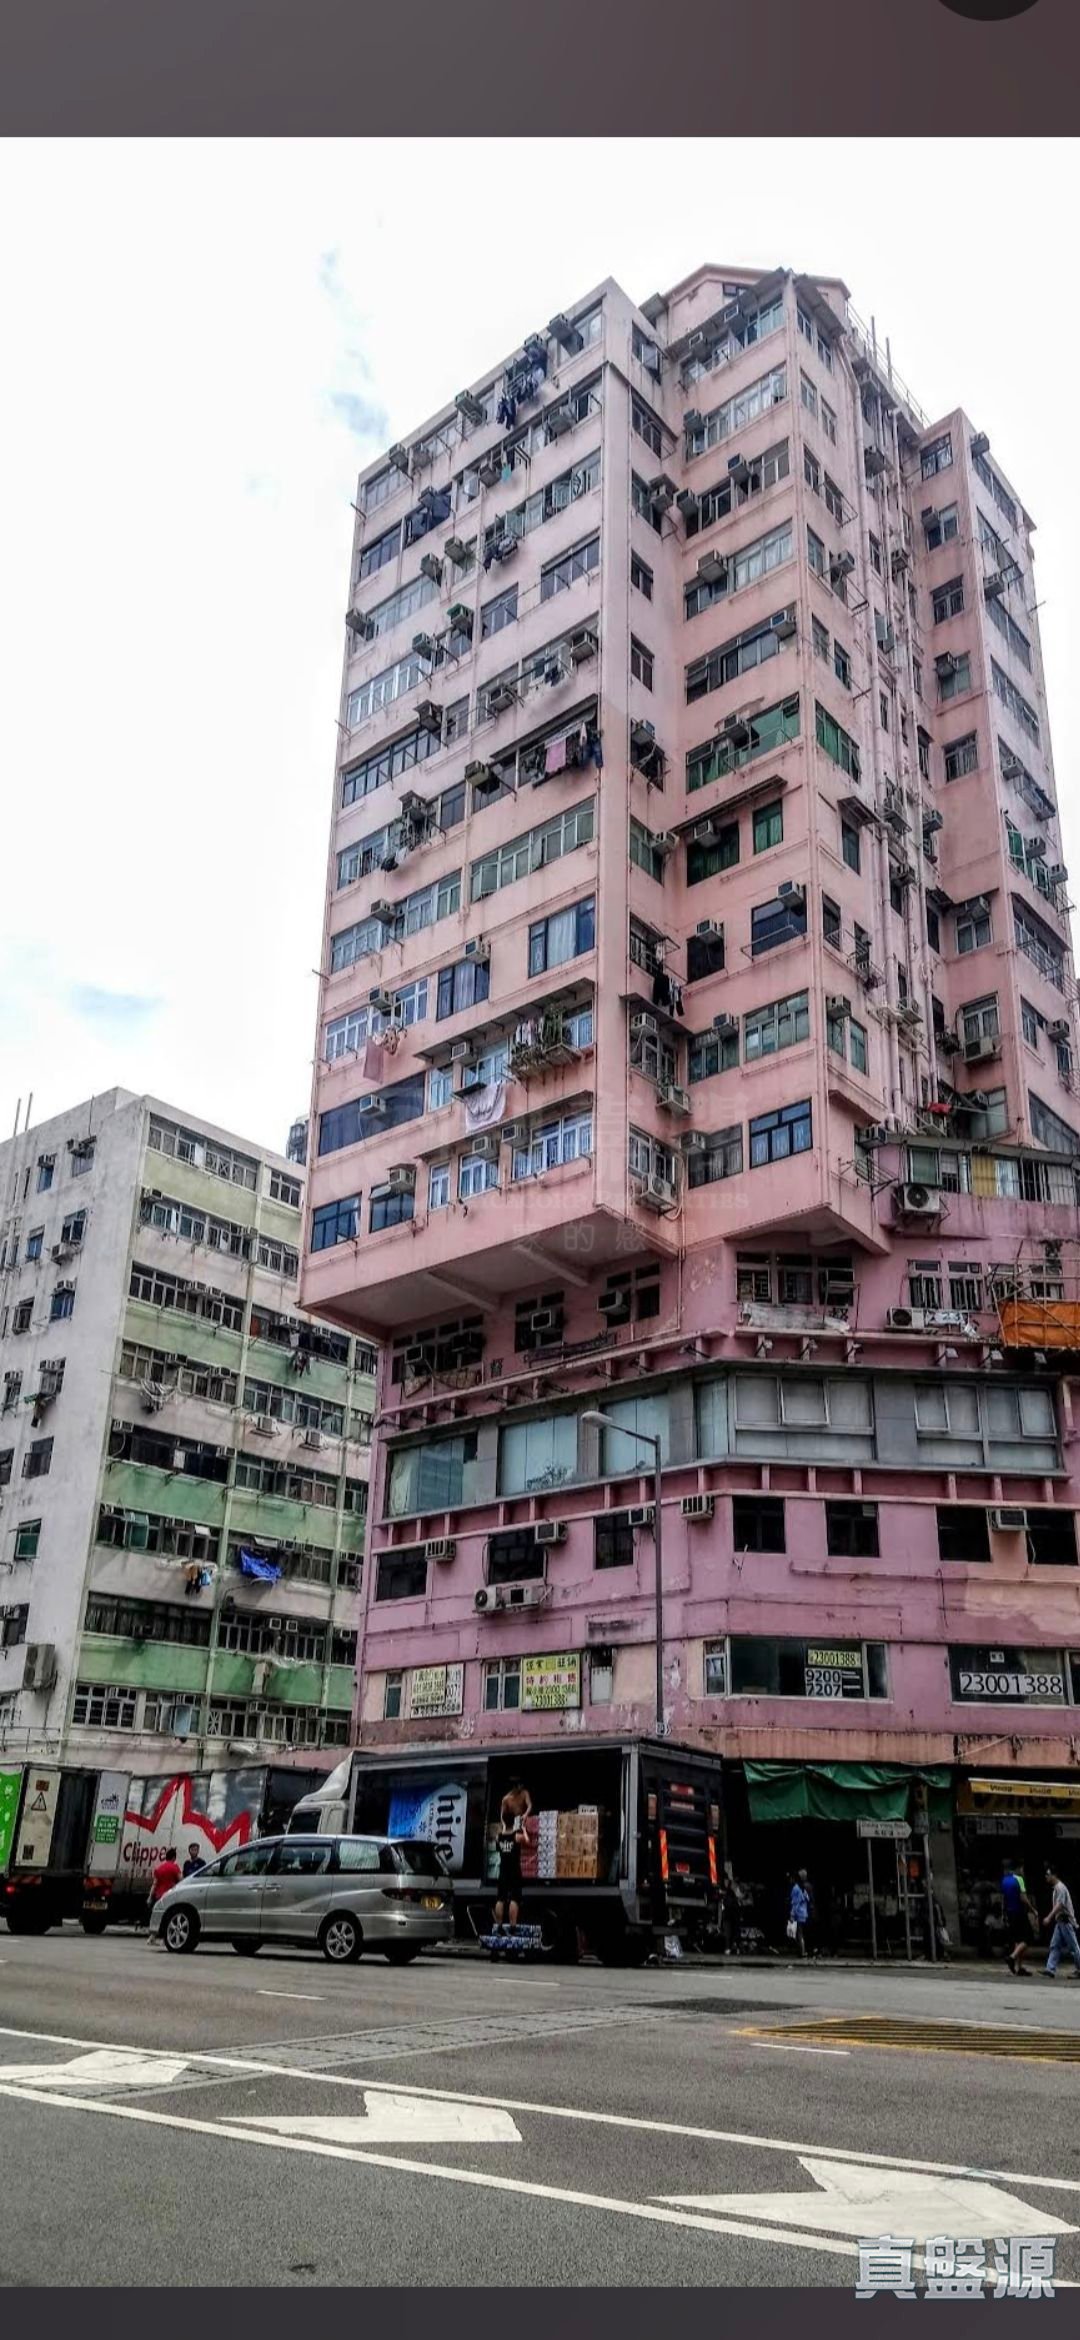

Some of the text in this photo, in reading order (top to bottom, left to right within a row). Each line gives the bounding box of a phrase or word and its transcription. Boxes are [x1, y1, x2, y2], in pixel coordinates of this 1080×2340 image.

[814, 1650, 856, 1666] 23001388
[805, 1670, 841, 1684] 9200
[960, 1673, 1063, 1695] 23001388
[806, 1684, 841, 1697] 7207
[434, 1794, 462, 1861] hite
